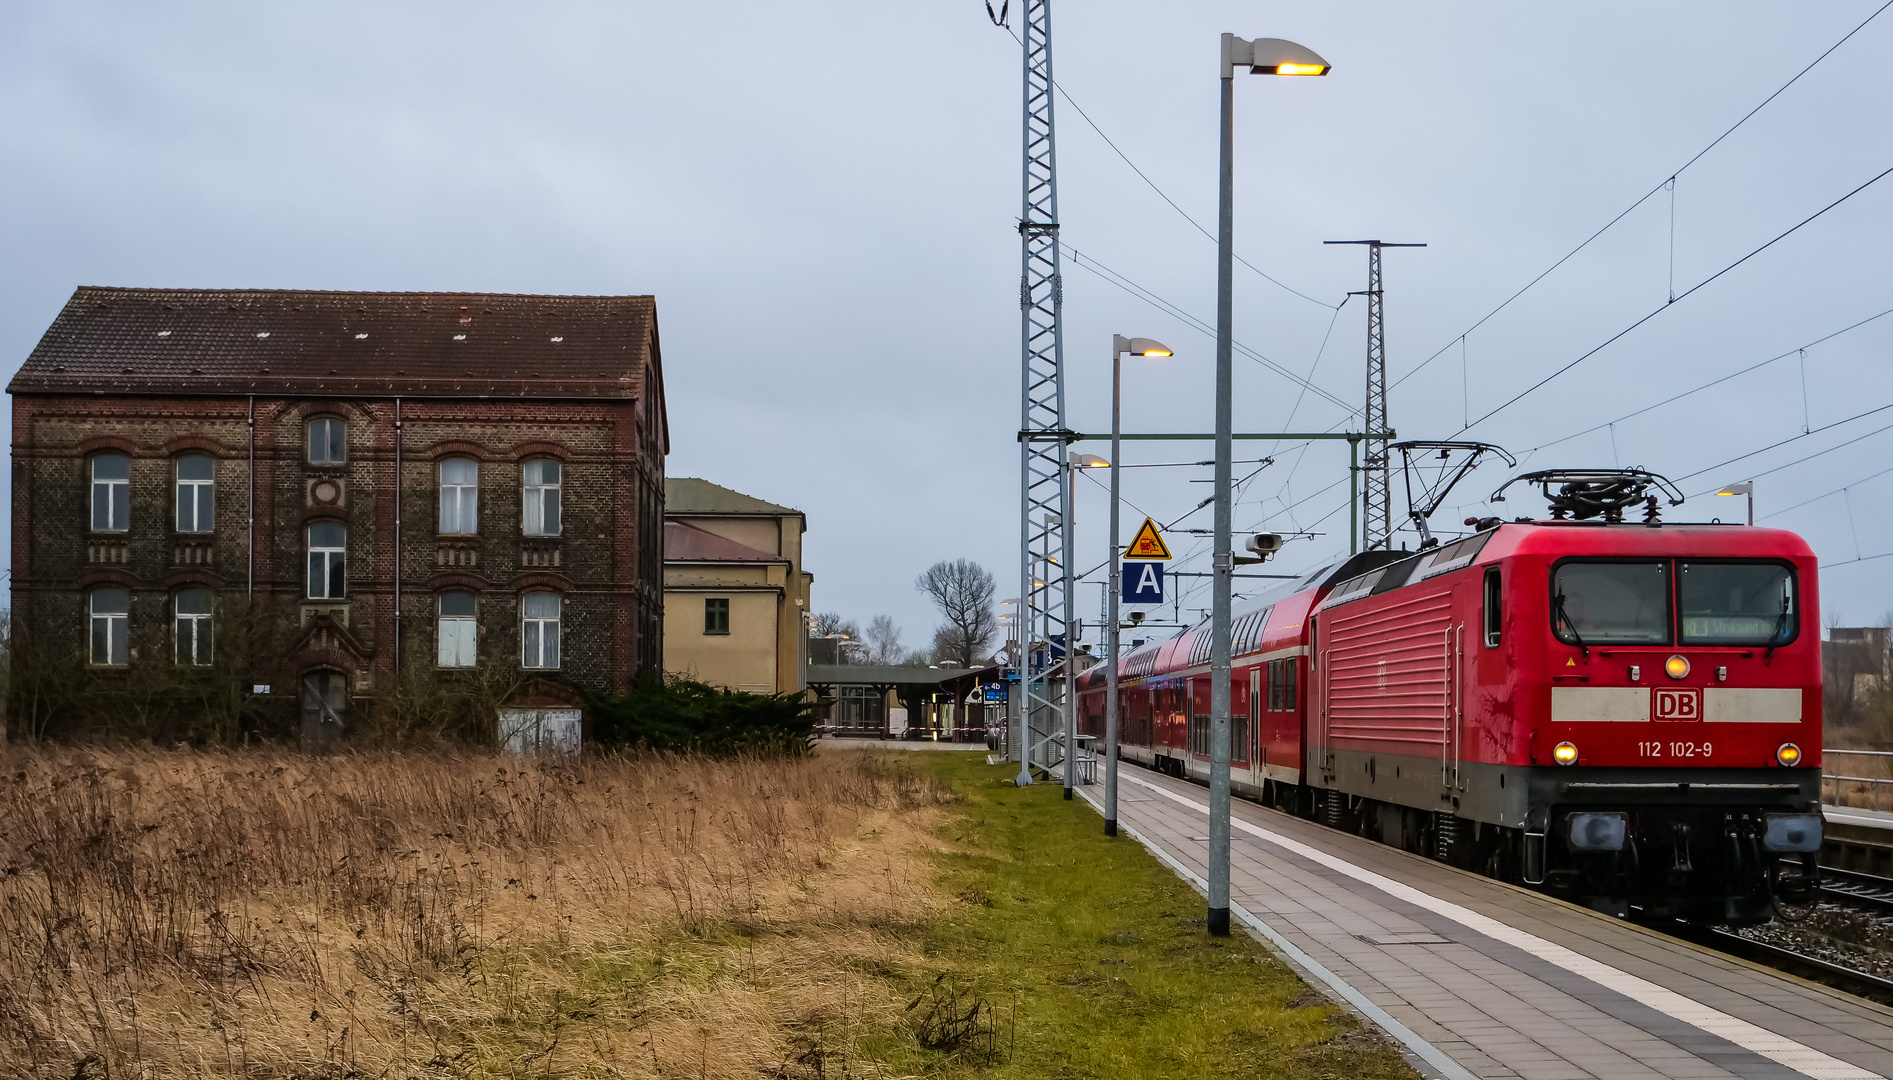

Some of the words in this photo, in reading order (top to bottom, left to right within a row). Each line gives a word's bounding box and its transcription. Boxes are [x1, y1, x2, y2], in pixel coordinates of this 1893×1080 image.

[1136, 564, 1160, 593] A
[1713, 619, 1758, 634] Stralsund
[991, 682, 1001, 690] 4b
[1660, 693, 1695, 716] DB
[1638, 741, 1661, 757] 112
[1669, 741, 1712, 757] 102-9
